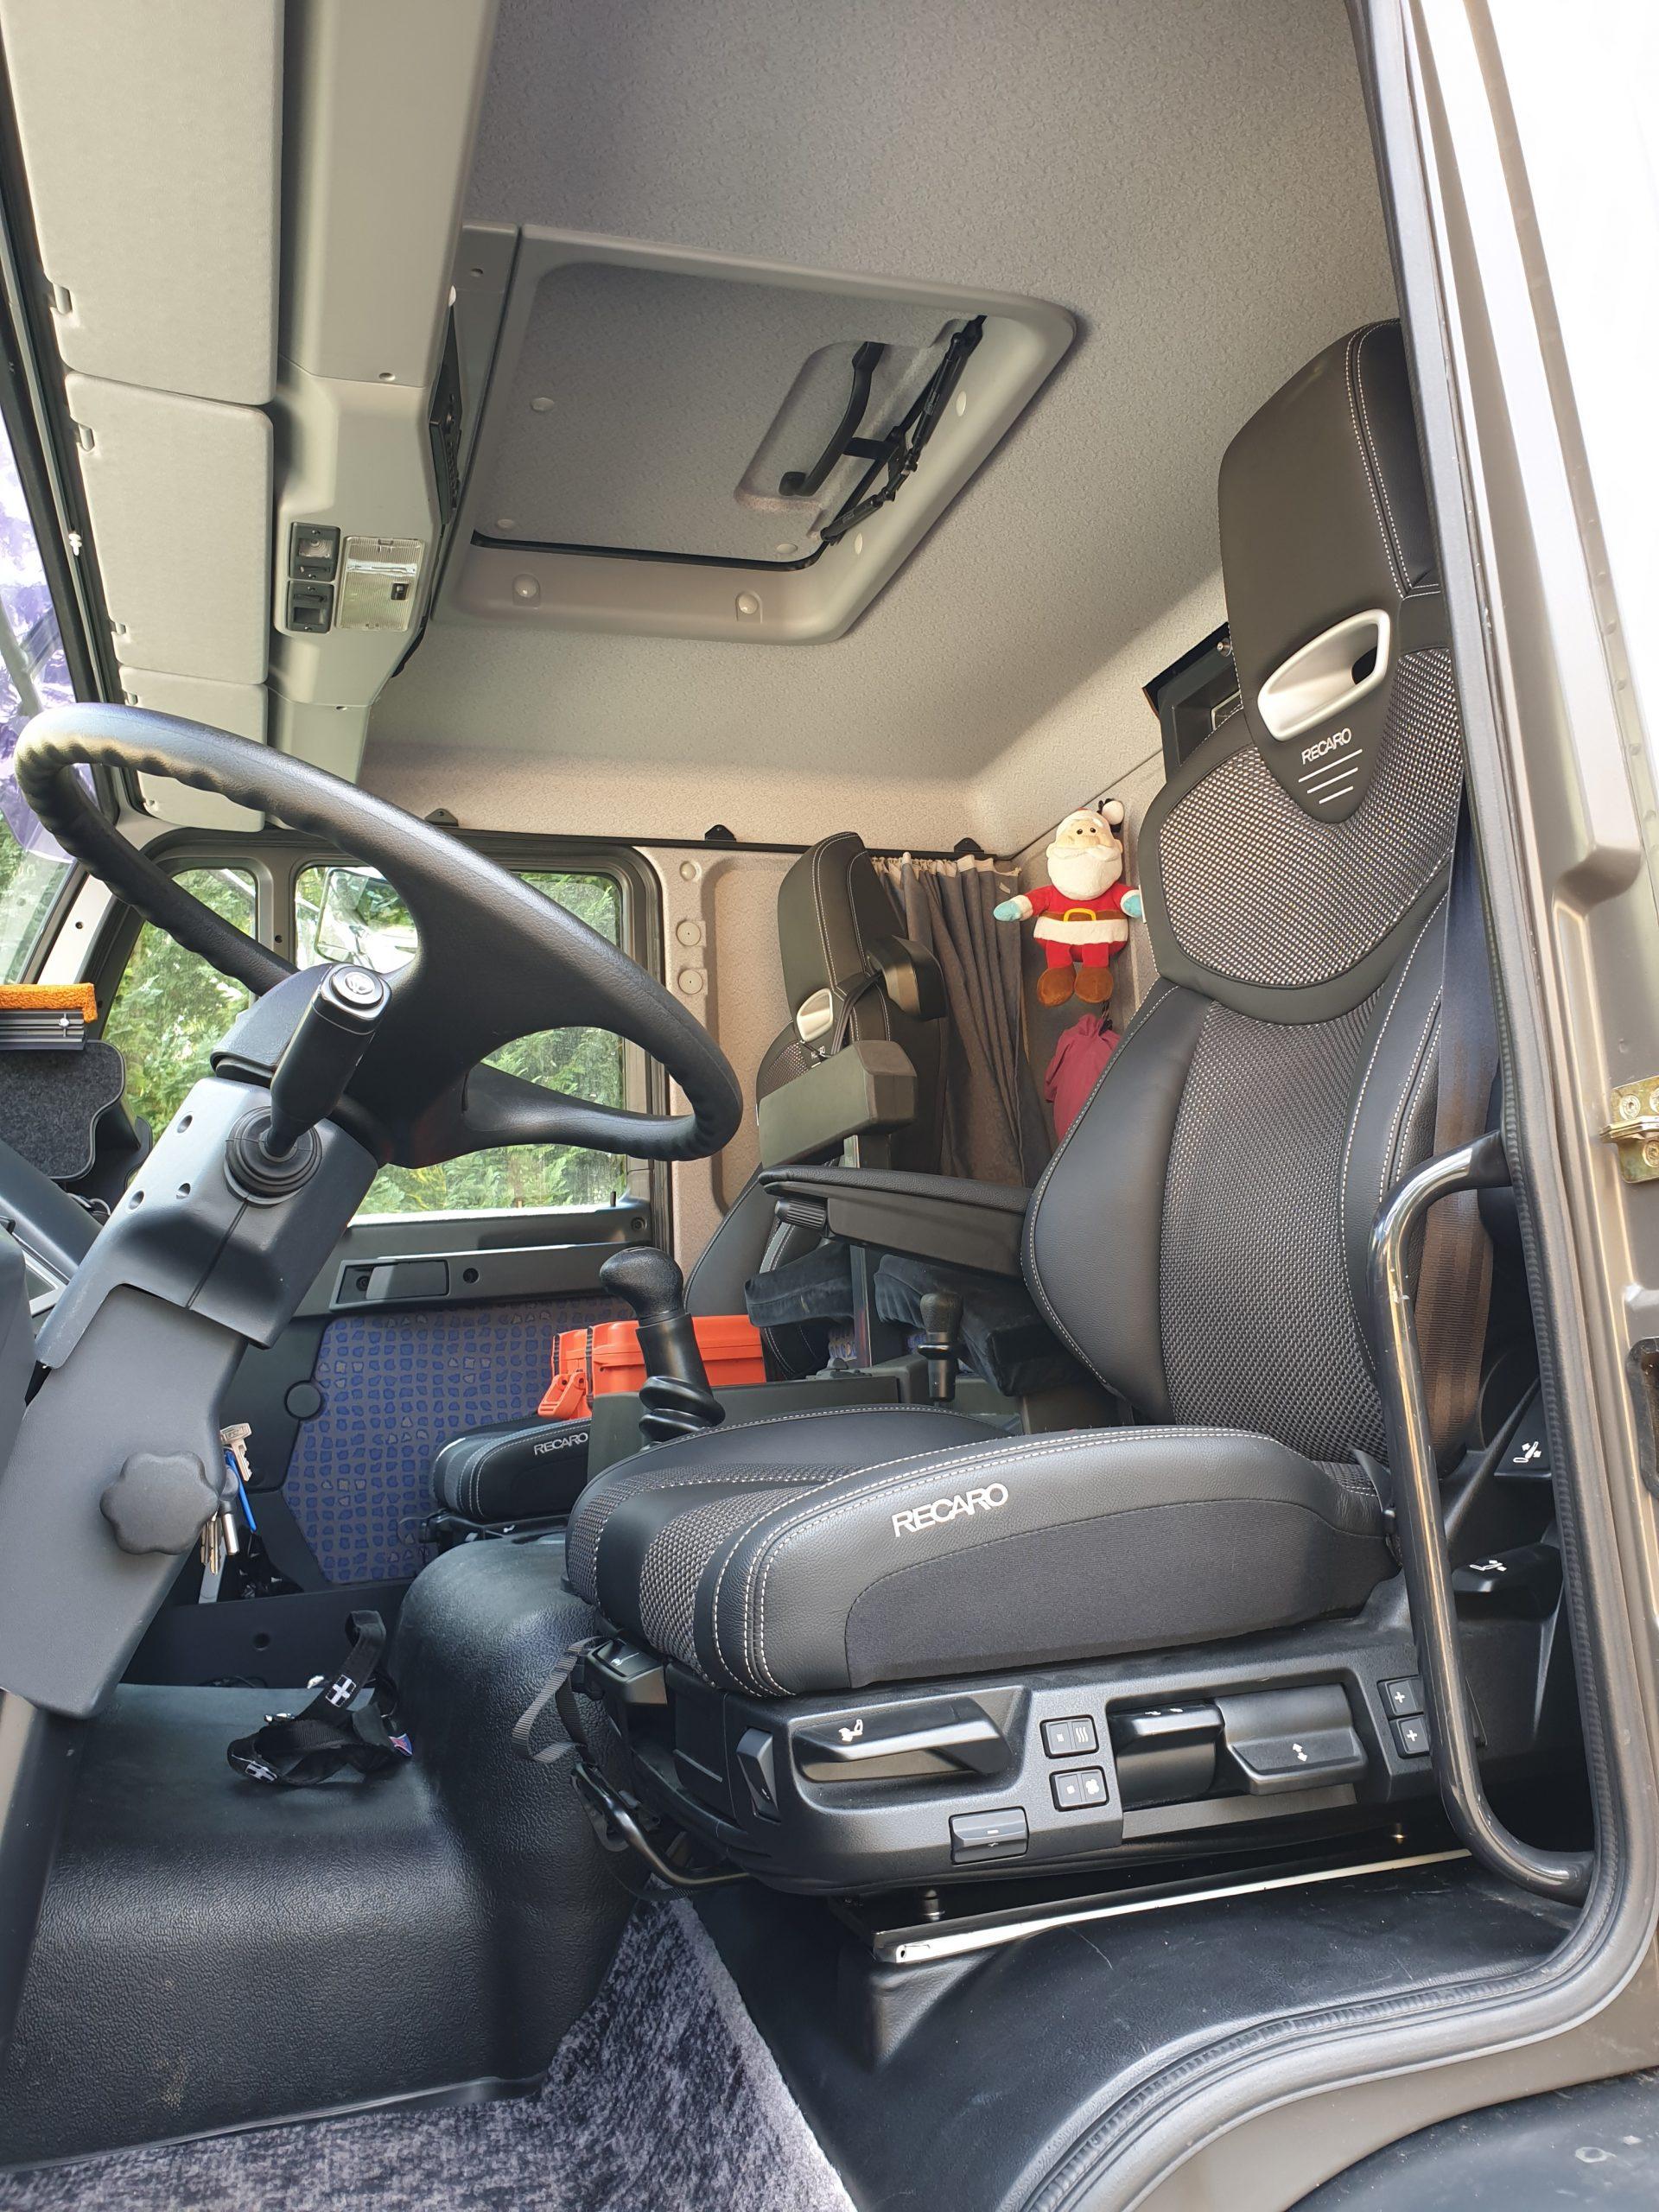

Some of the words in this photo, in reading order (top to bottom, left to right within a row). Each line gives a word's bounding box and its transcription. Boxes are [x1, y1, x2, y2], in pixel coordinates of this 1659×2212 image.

[1301, 728, 1352, 765] RECARO
[533, 1432, 588, 1455] RECARO
[891, 1482, 1009, 1538] RECARO
